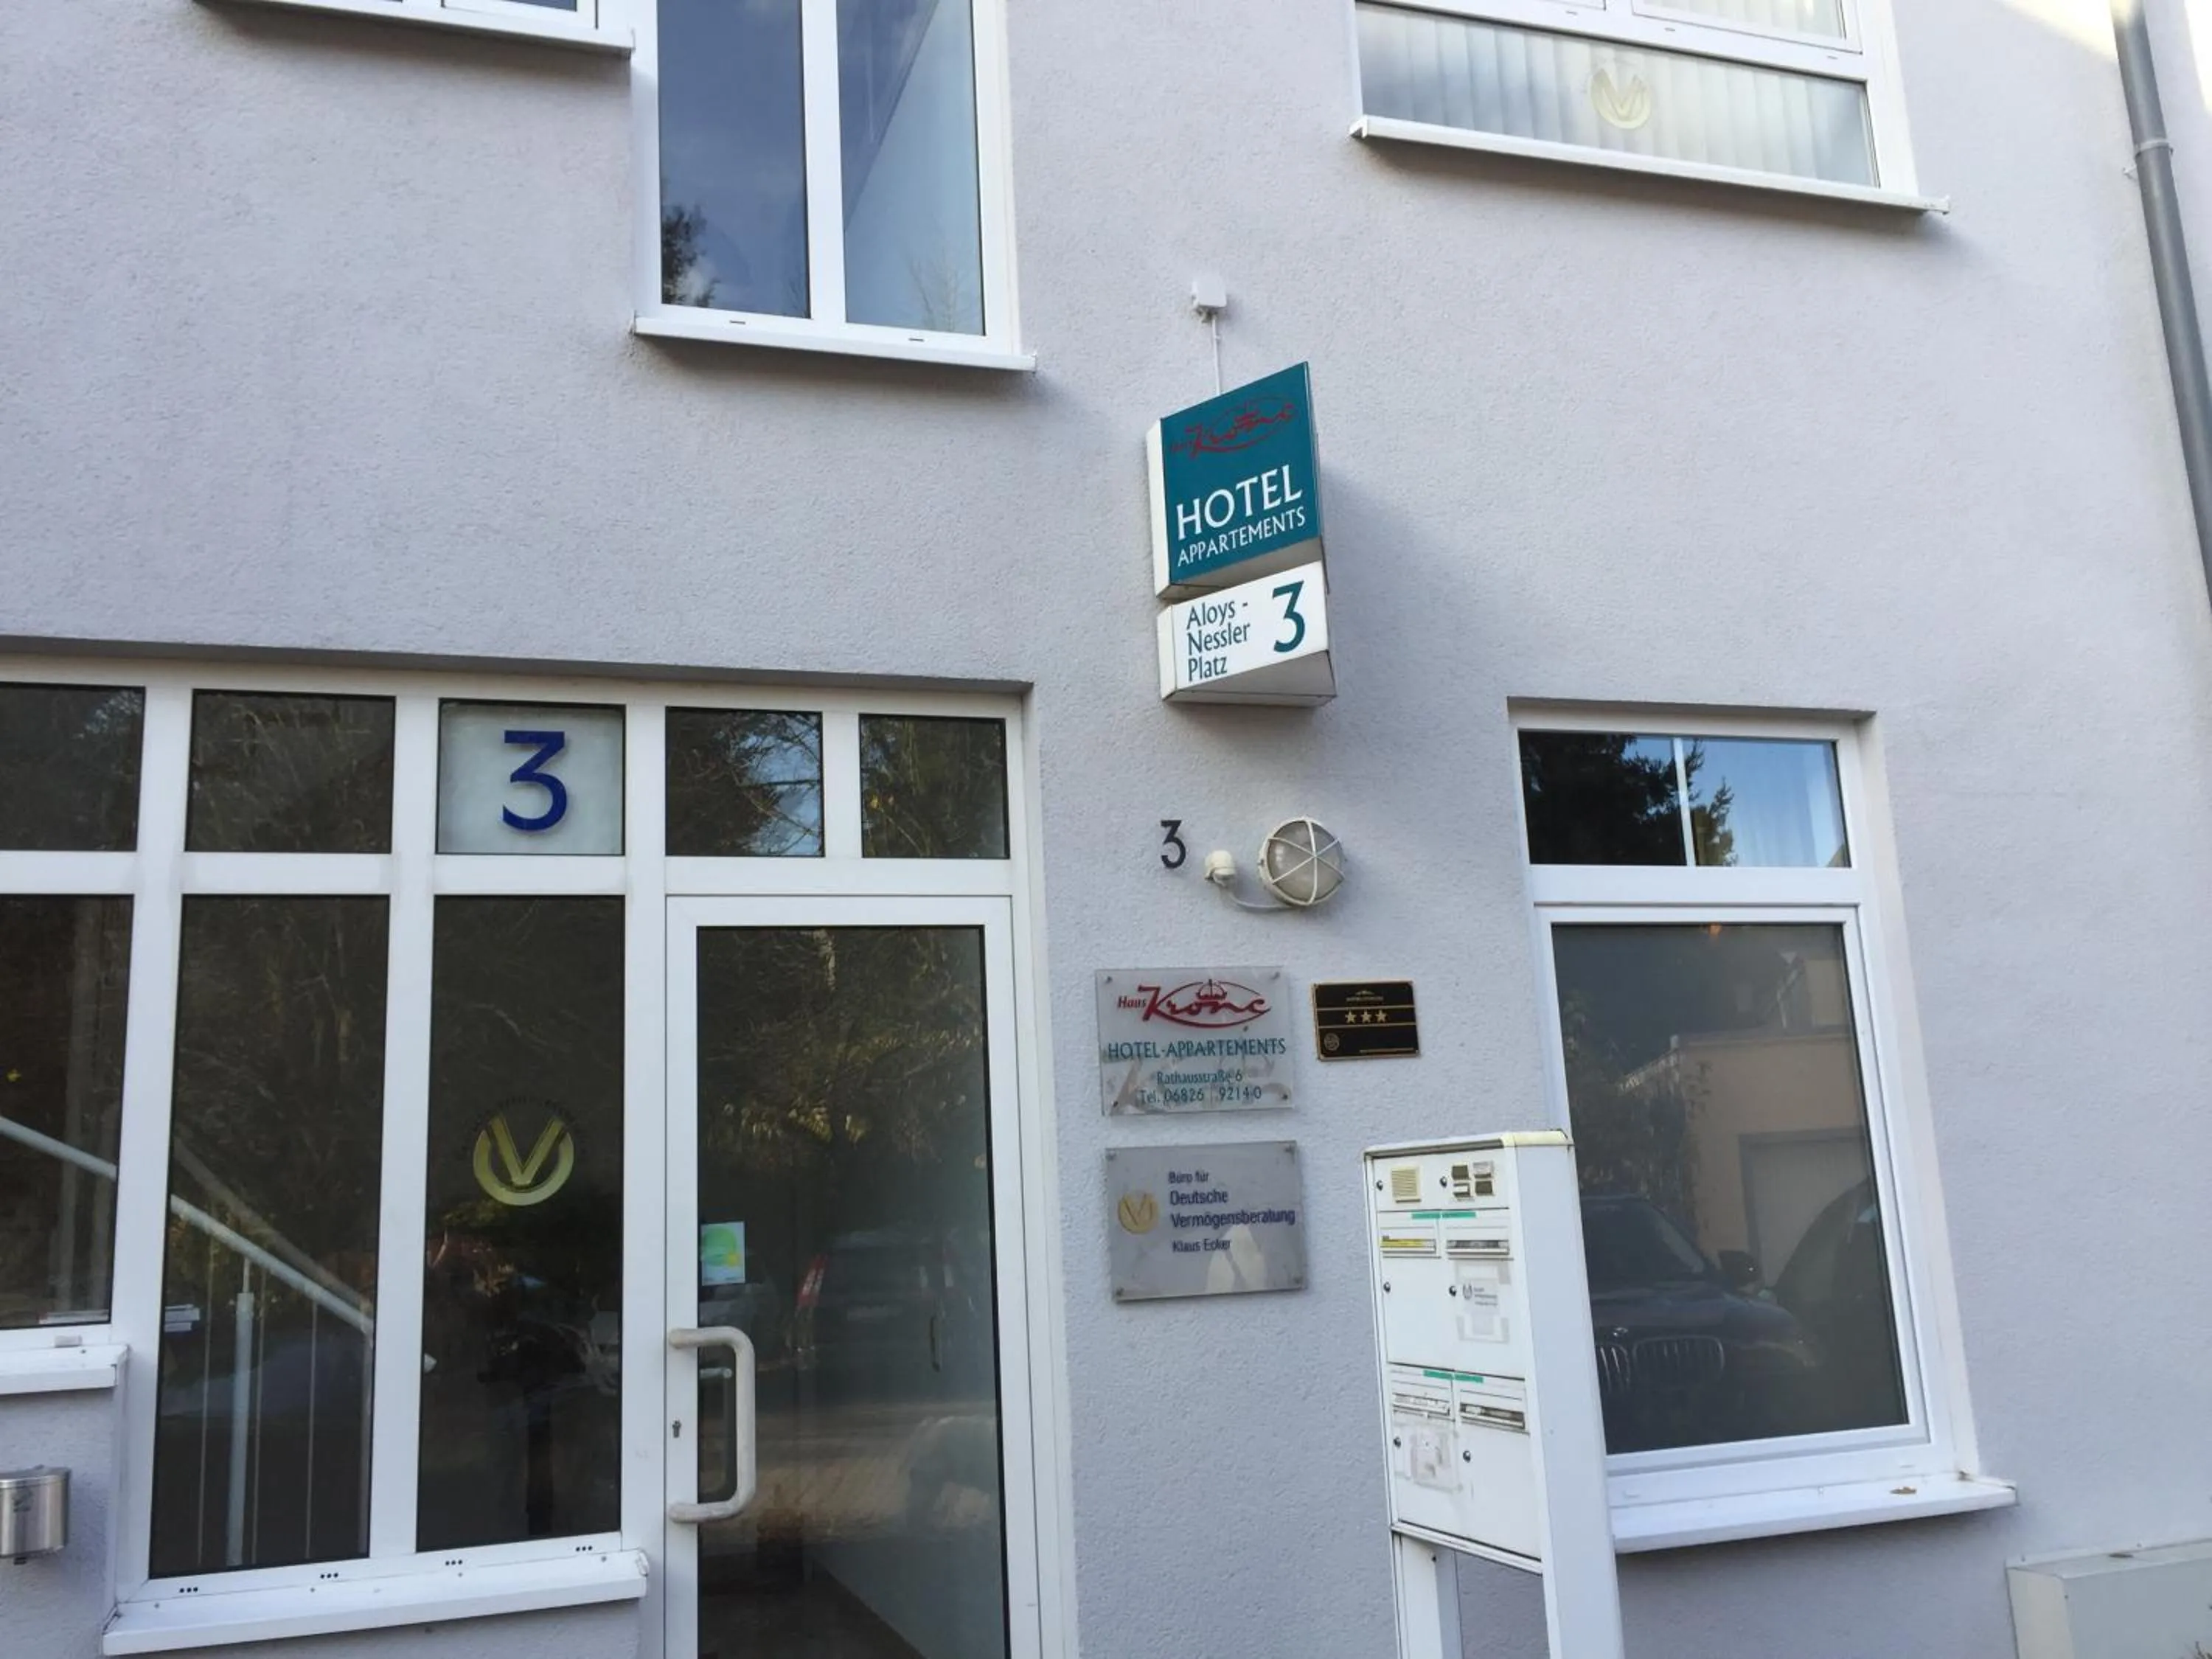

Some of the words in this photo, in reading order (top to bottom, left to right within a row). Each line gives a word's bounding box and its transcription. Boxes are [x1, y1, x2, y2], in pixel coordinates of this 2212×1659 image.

[1177, 464, 1303, 540] HOTEL
[1178, 506, 1306, 567] APPARTEMENTS
[1271, 580, 1305, 653] 3
[1187, 622, 1251, 656] Nessler
[1188, 655, 1228, 682] Platz
[502, 729, 567, 831] 3
[1161, 819, 1186, 869] 3
[1117, 995, 1147, 1009] Haus
[1138, 984, 1272, 1024] Krone
[1234, 1068, 1243, 1082] 6
[1164, 1088, 1205, 1103] 06826
[1170, 1189, 1229, 1206] Deutsche
[1170, 1208, 1295, 1229] Vermögensberatung
[1172, 1239, 1201, 1253] Klaus
